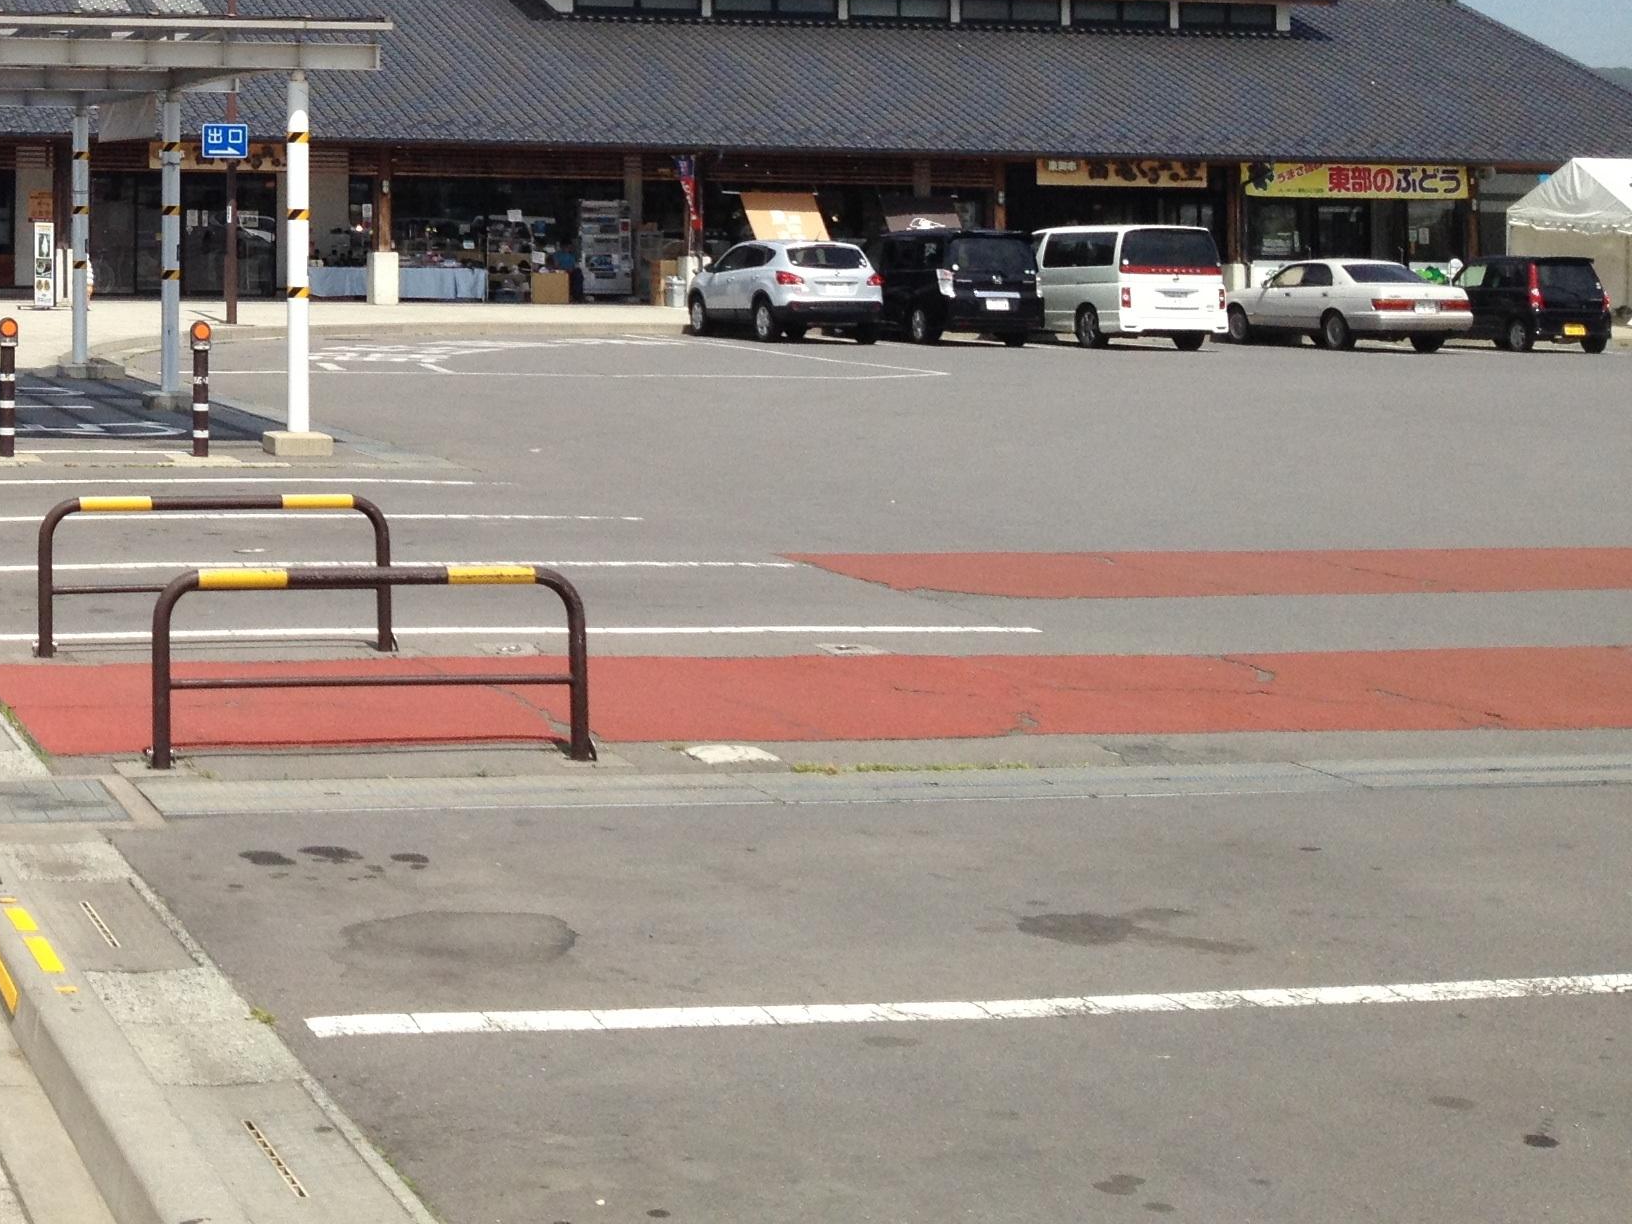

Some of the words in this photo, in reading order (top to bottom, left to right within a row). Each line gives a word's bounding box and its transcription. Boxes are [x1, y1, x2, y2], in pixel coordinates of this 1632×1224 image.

[208, 128, 243, 144] 出口
[1327, 166, 1461, 194] 東部のぶどう
